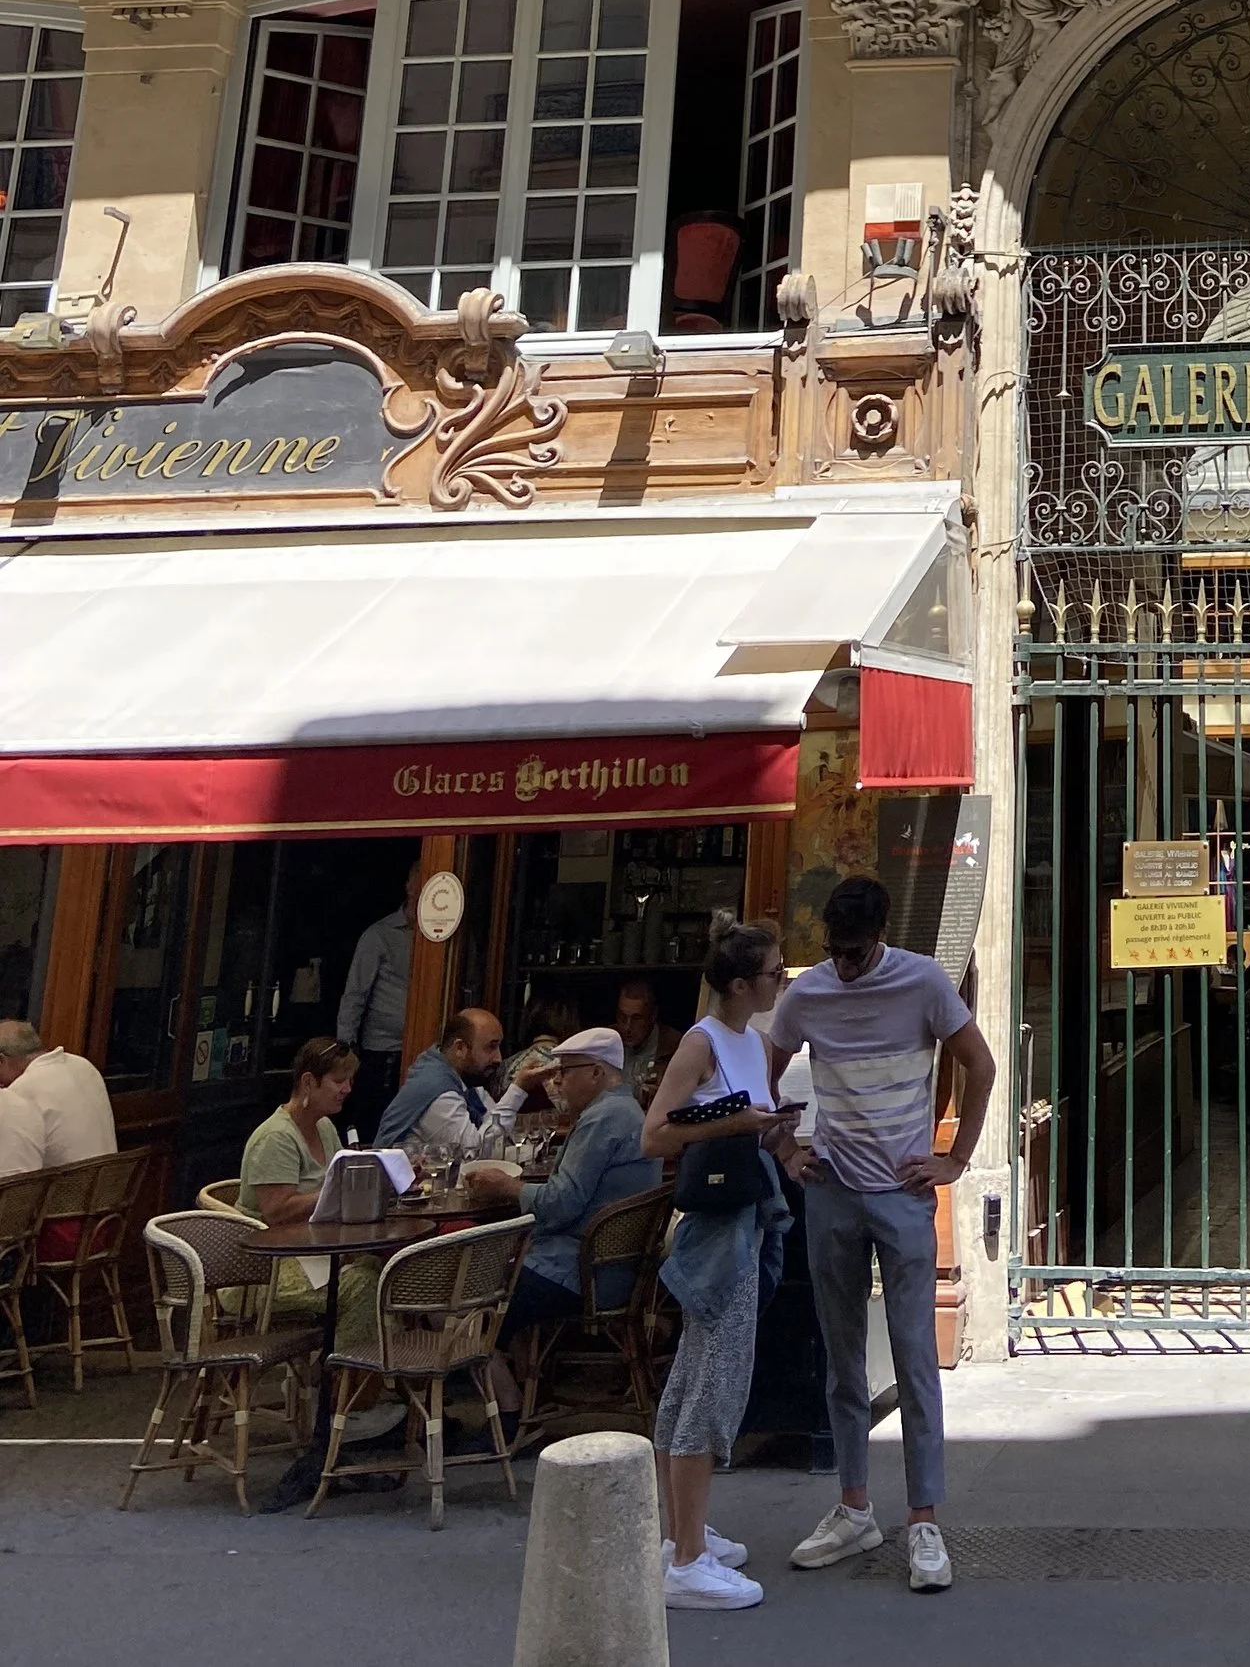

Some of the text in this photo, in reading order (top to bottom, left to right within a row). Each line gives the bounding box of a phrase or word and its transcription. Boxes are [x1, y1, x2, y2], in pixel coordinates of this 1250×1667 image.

[29, 409, 341, 482] Vivienne
[393, 754, 690, 801] Glaces Berthillon
[1137, 901, 1198, 911] GALERIE VIVIENNE
[1134, 913, 1165, 921] OUVERTE
[1177, 912, 1202, 920] PUBLIC
[1140, 924, 1149, 932] de
[1125, 936, 1152, 944] passage
[1153, 934, 1171, 943] privé
